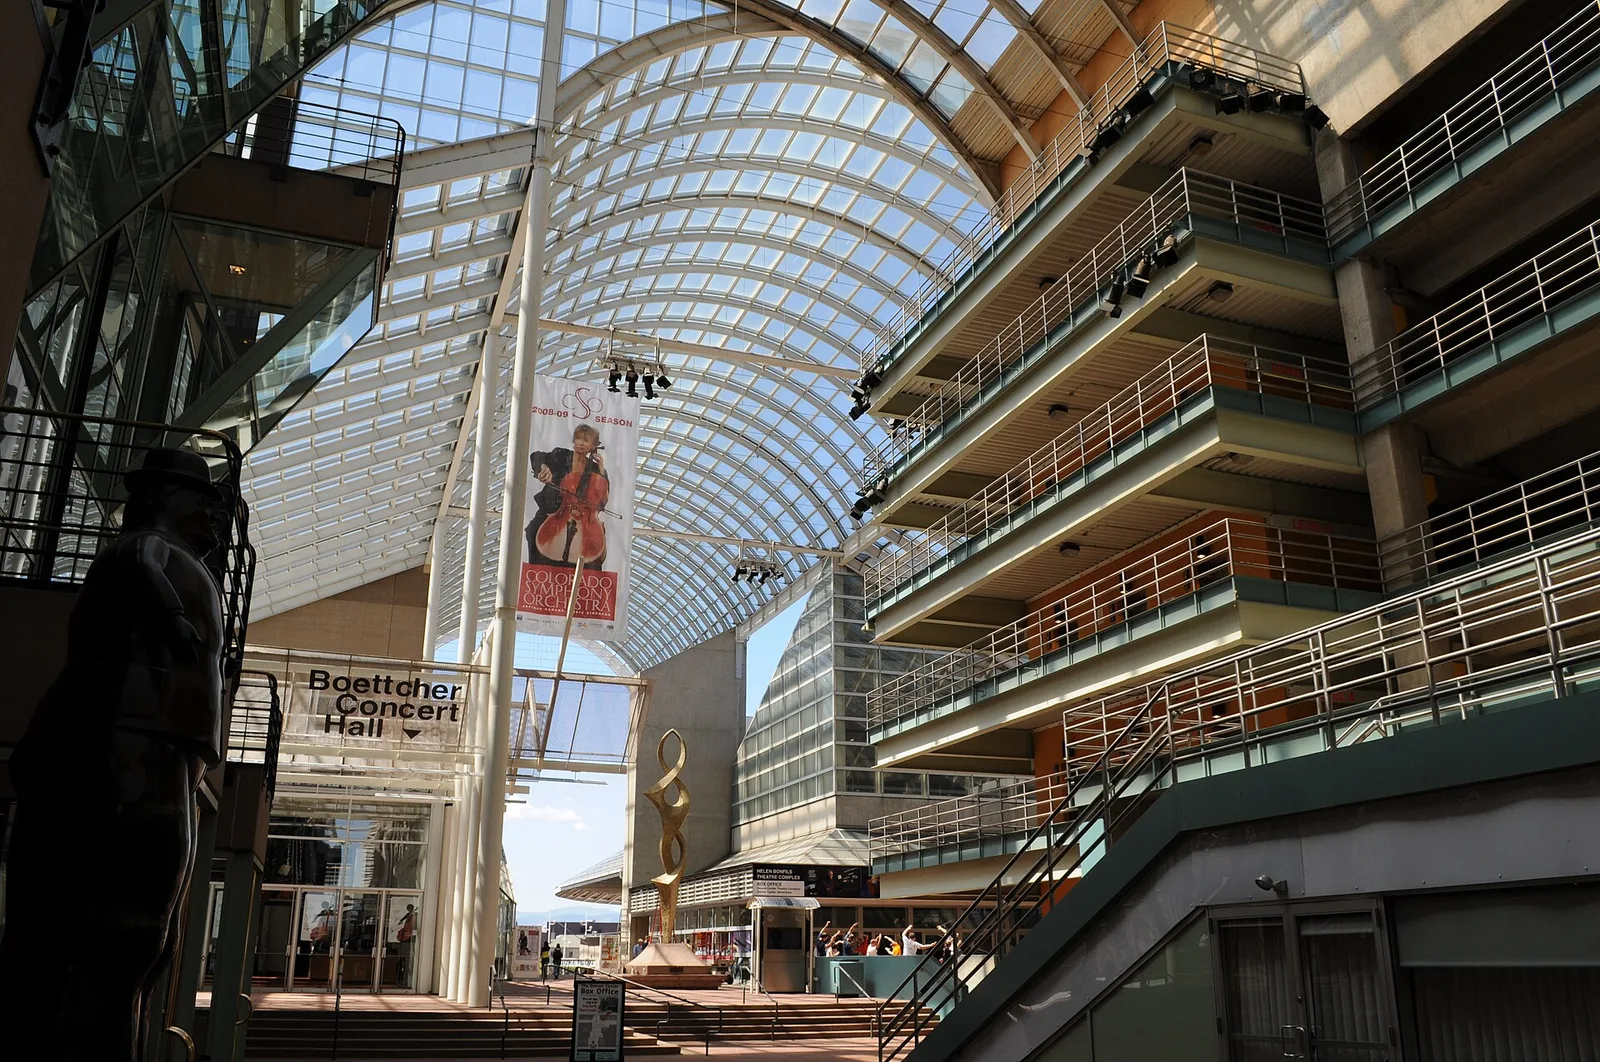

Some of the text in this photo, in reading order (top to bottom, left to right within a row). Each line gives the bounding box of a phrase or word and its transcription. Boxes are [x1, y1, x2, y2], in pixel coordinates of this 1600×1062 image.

[532, 406, 568, 418] 2008-09
[595, 415, 633, 428] SEASON
[526, 569, 612, 589] COLORADO
[525, 580, 612, 601] SYMPHONY
[523, 592, 611, 613] ORCHSTRA
[309, 669, 462, 701] Boettcher
[335, 693, 460, 722] Concert
[324, 714, 384, 738] Hall
